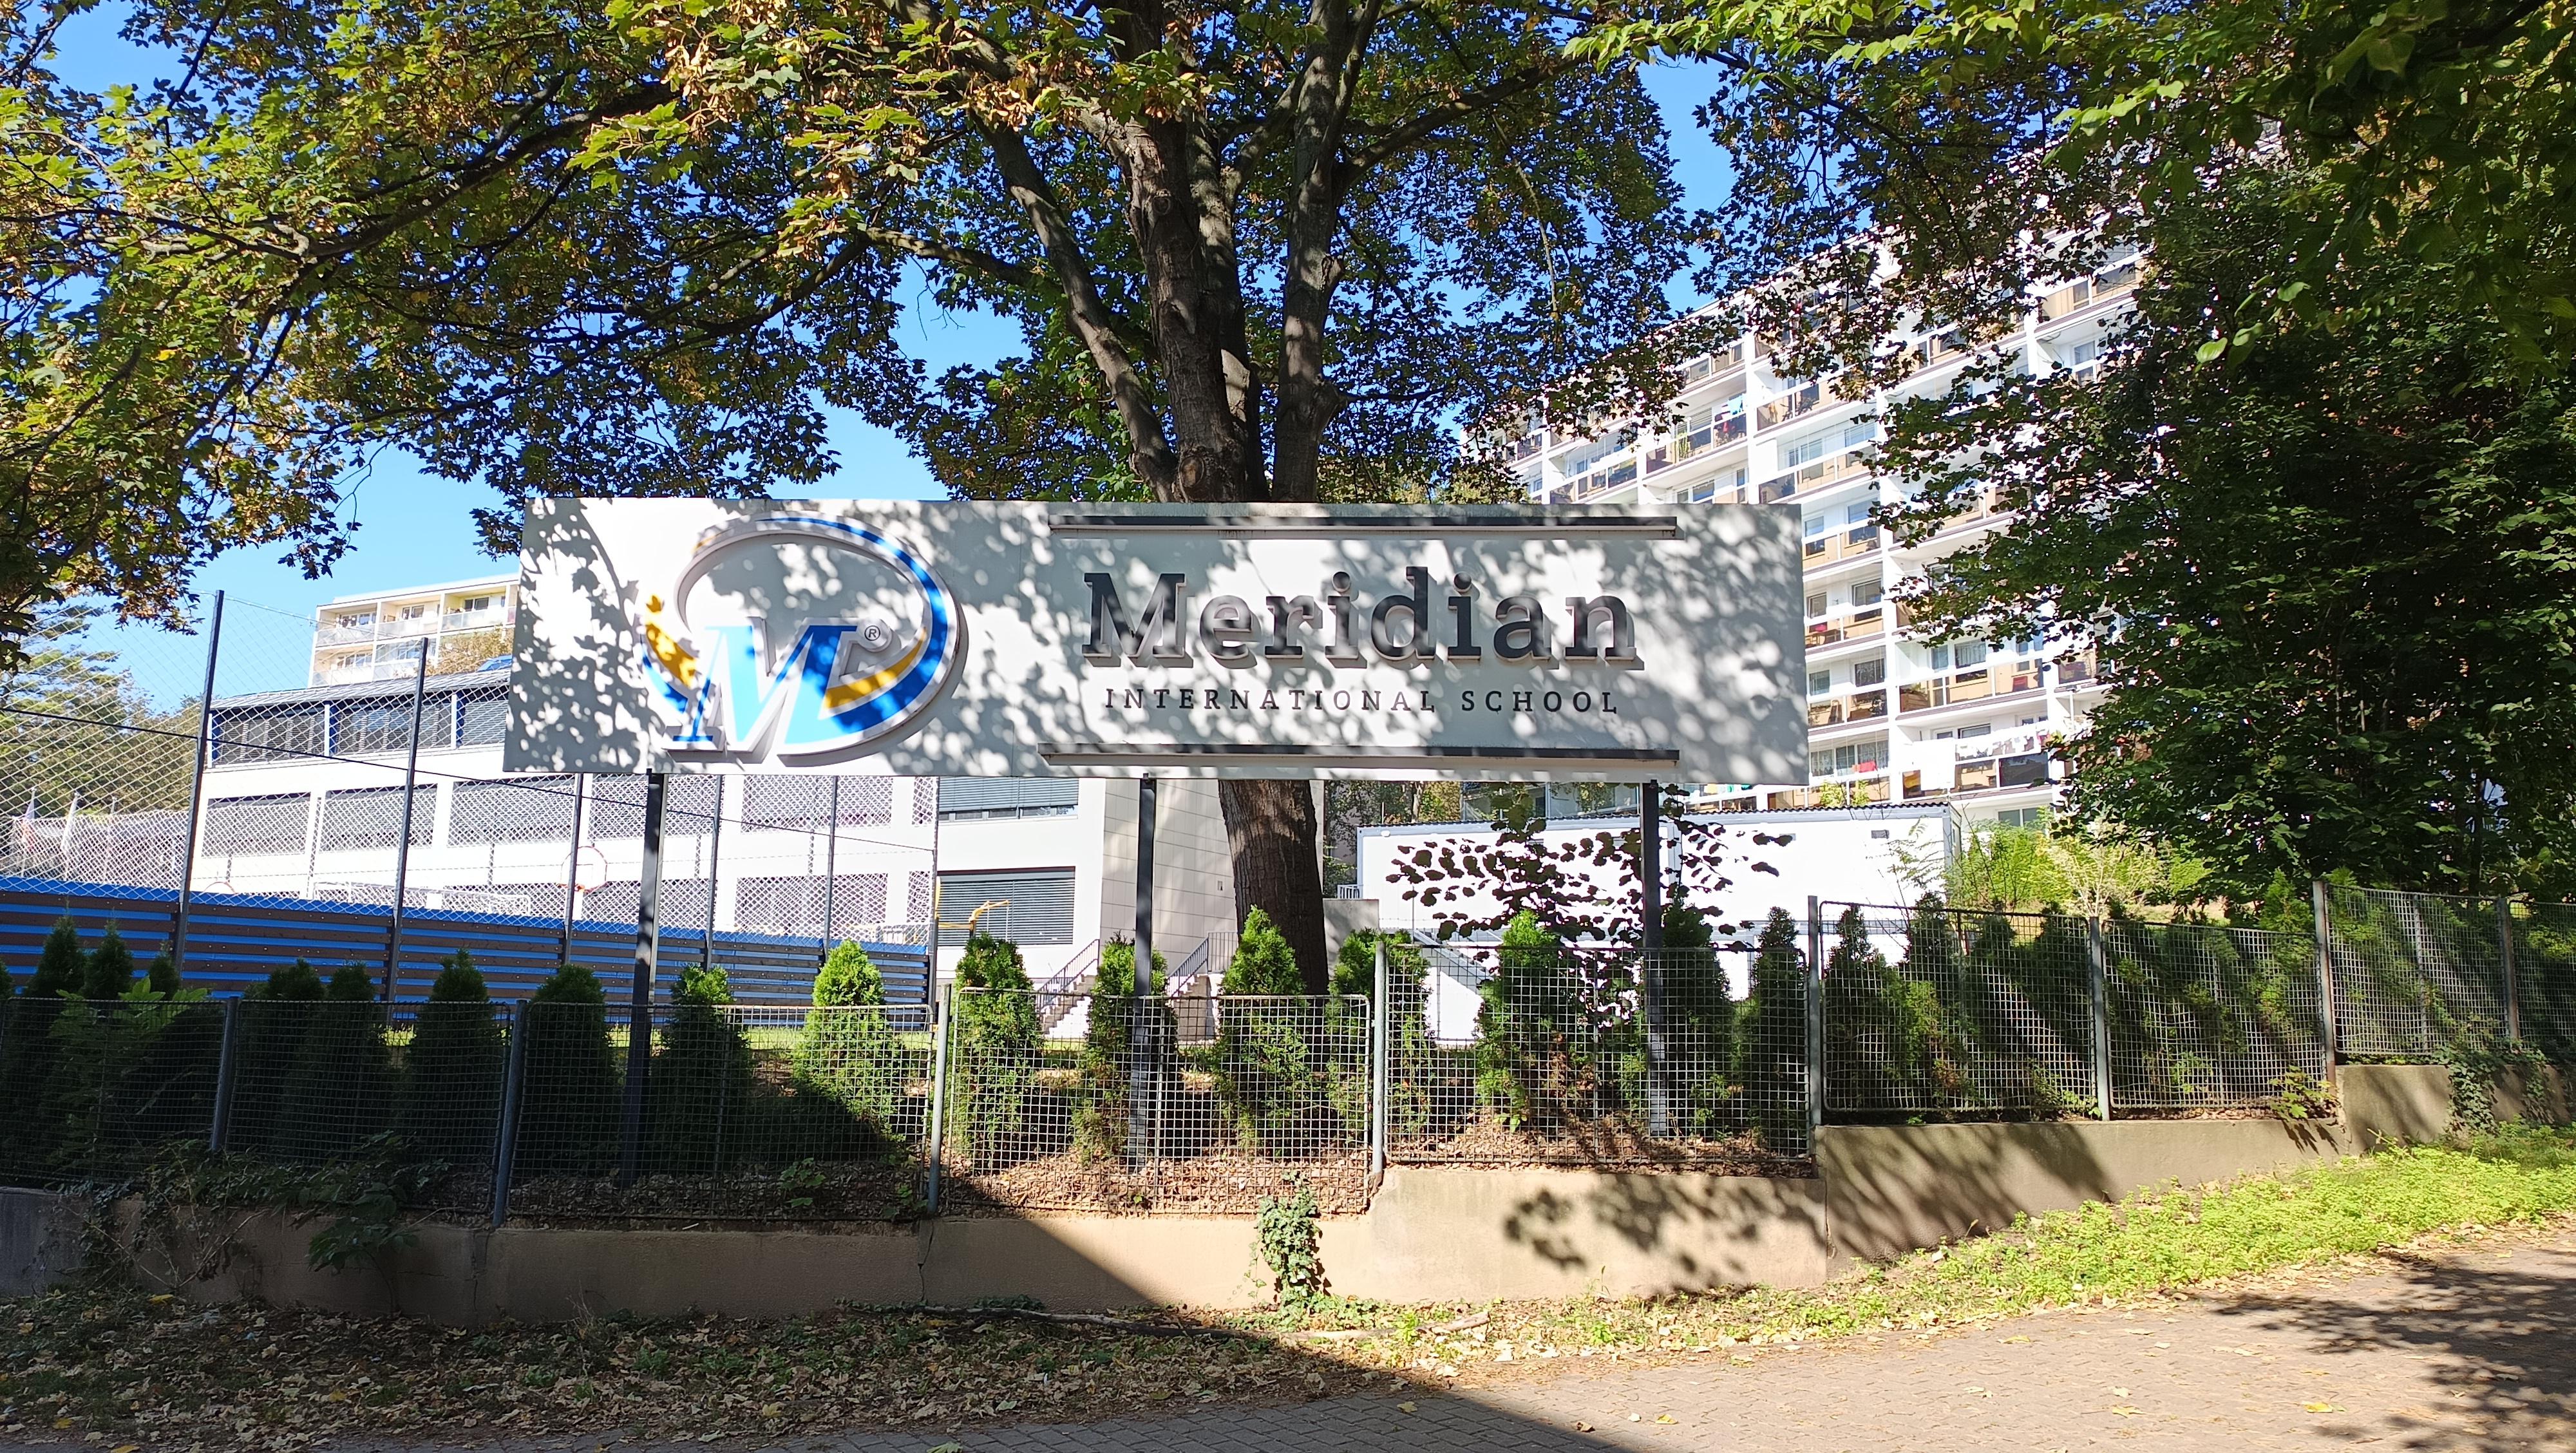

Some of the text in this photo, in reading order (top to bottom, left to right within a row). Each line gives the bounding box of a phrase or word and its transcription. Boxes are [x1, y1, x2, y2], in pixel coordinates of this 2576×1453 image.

[1082, 565, 1637, 660] Meridian
[1105, 688, 1618, 714] INTERNATIONAL SCHOOL
